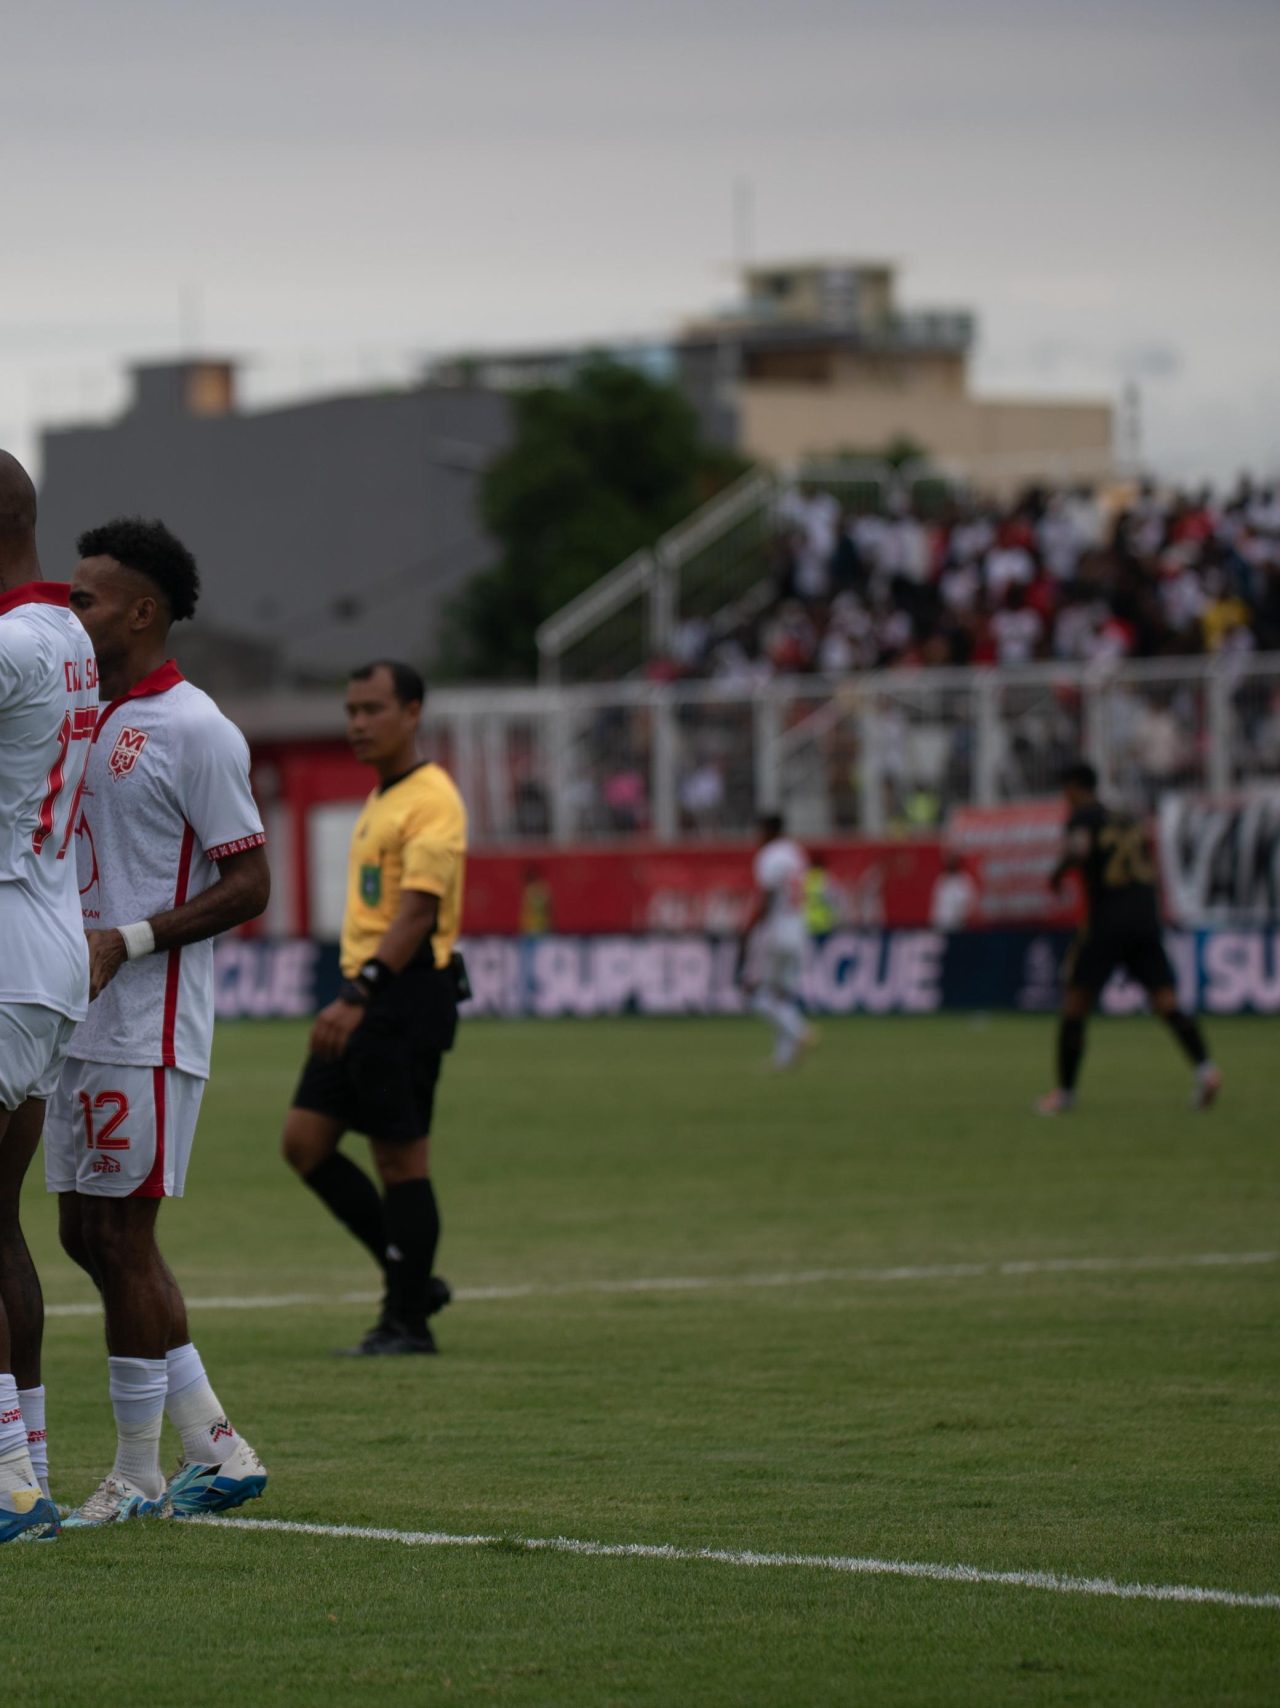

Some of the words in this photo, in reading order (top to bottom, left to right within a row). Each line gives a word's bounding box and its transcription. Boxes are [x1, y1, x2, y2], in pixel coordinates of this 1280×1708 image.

[32, 706, 99, 860] 17
[532, 938, 706, 1017] SUPER
[715, 936, 946, 1012] LGUE
[1201, 935, 1280, 1013] SU
[79, 1089, 130, 1150] 12
